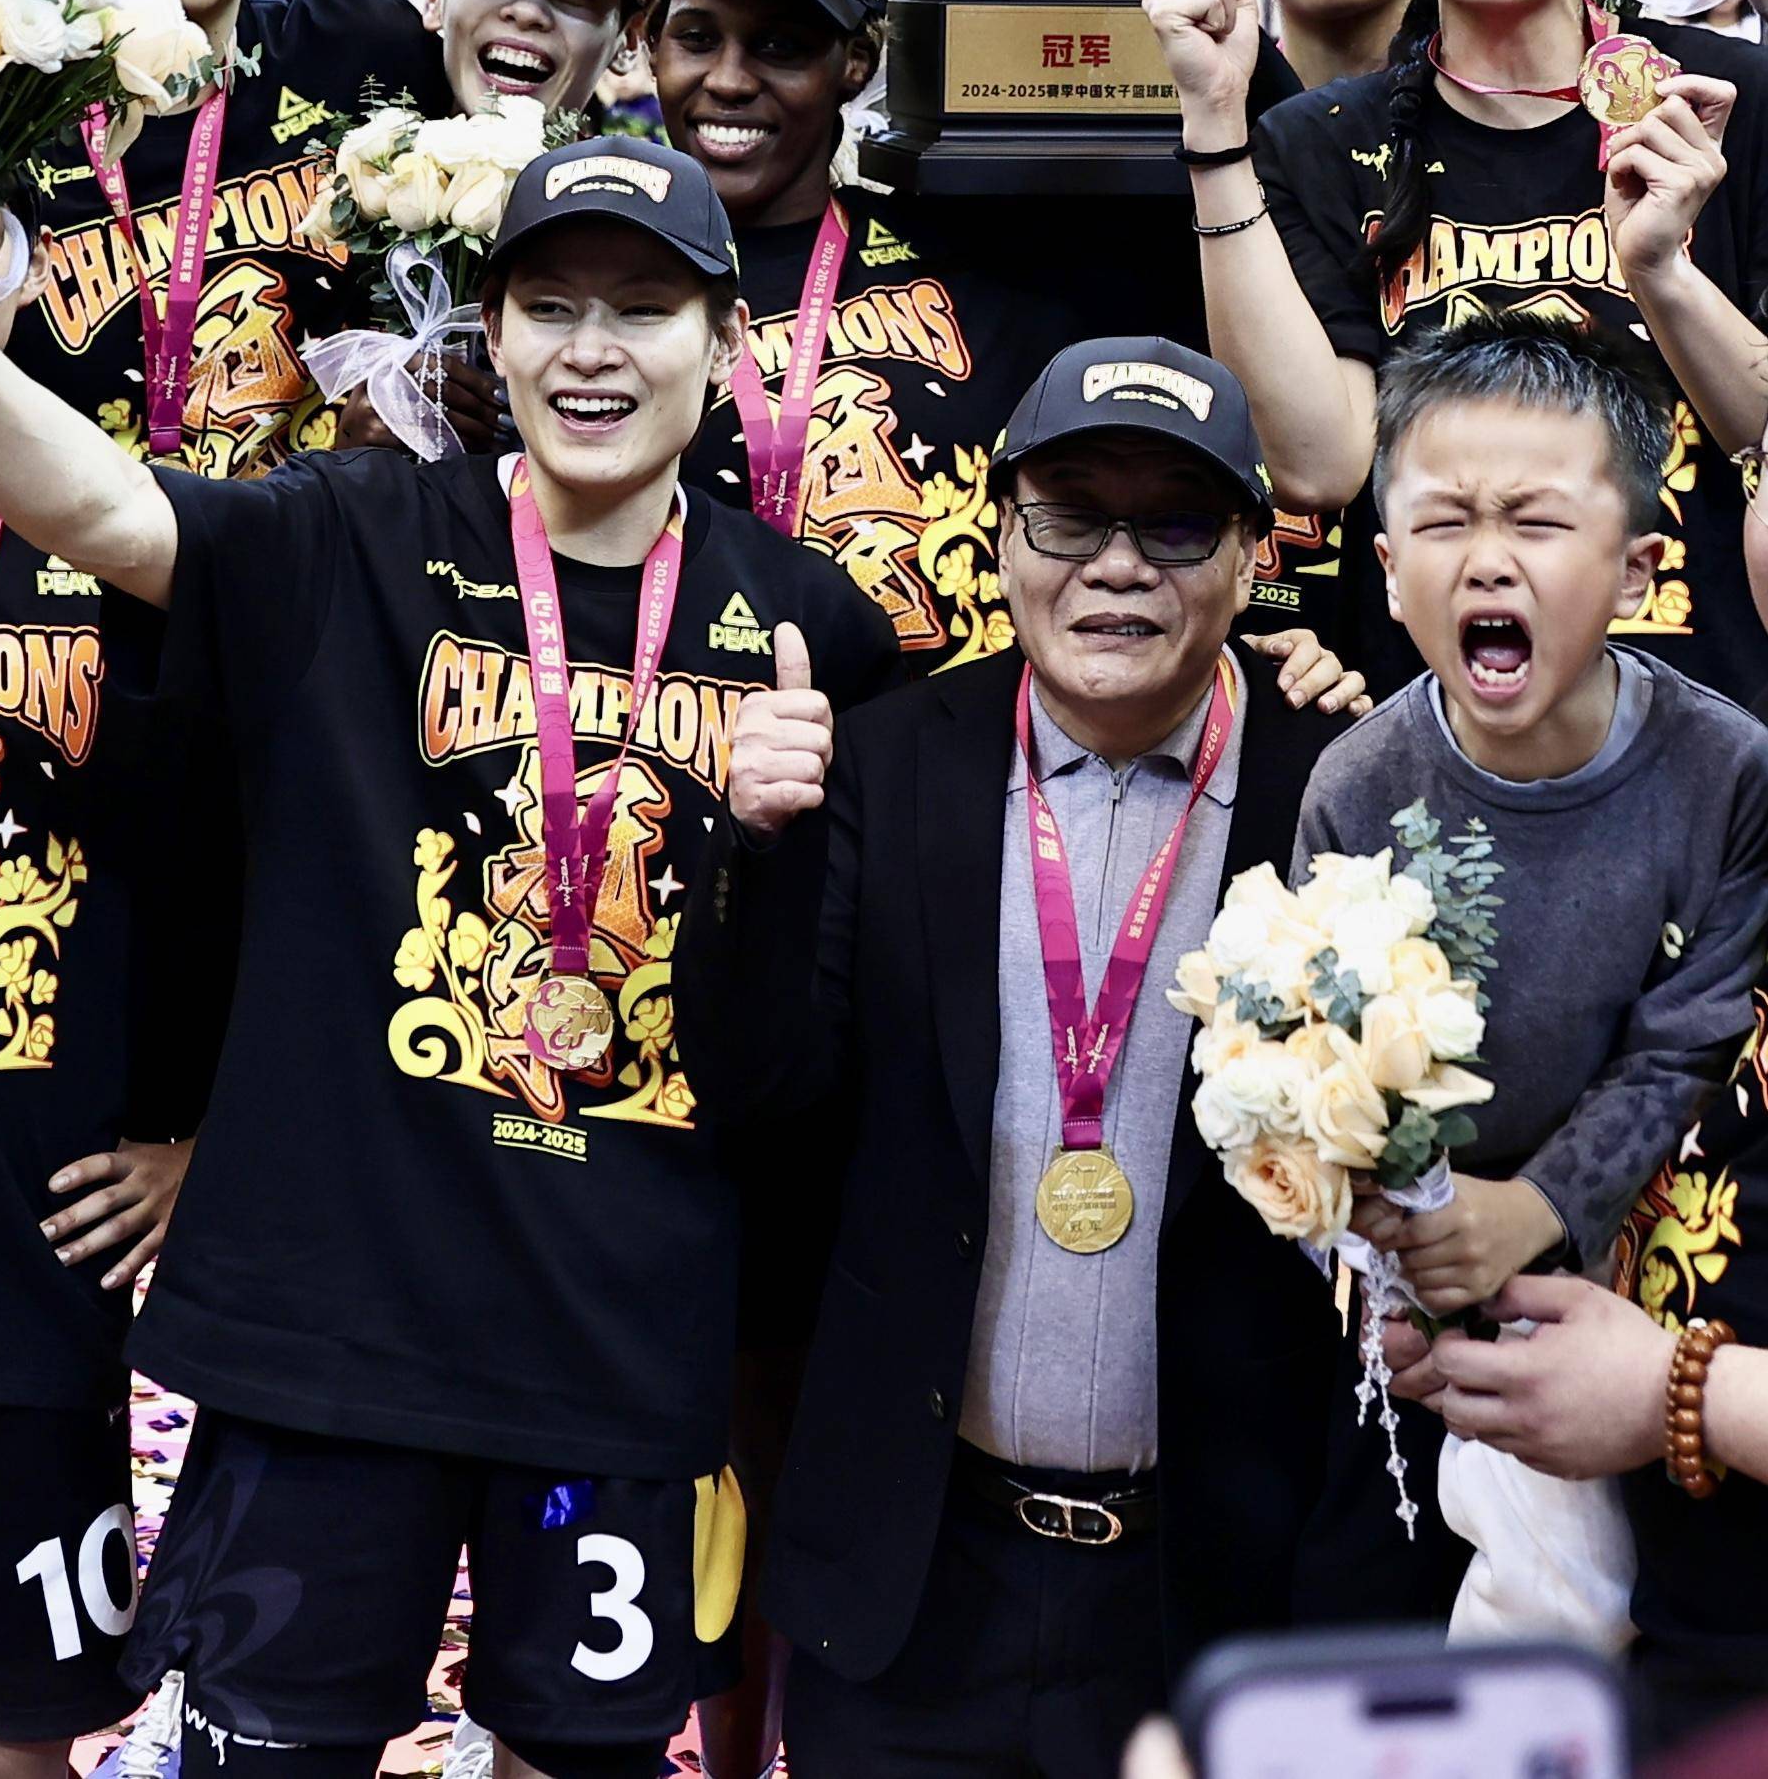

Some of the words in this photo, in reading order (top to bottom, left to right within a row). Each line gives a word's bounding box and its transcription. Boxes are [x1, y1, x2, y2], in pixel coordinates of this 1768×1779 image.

[1041, 34, 1111, 68] 冠军
[271, 101, 335, 144] PEAK
[545, 155, 674, 204] CHAMPIONS
[814, 242, 838, 295] 2024-2025
[859, 242, 920, 267] PEAK
[1082, 361, 1215, 424] CHAMPIONS
[36, 570, 101, 597] PEAK
[426, 559, 520, 600] WCBA
[646, 559, 669, 638] 2024-2025
[530, 590, 564, 698] 心不可挡
[708, 622, 773, 655] PEAK
[493, 1118, 587, 1156] 2024-2025
[16, 1501, 138, 1661] 10
[571, 1533, 654, 1682] 3
